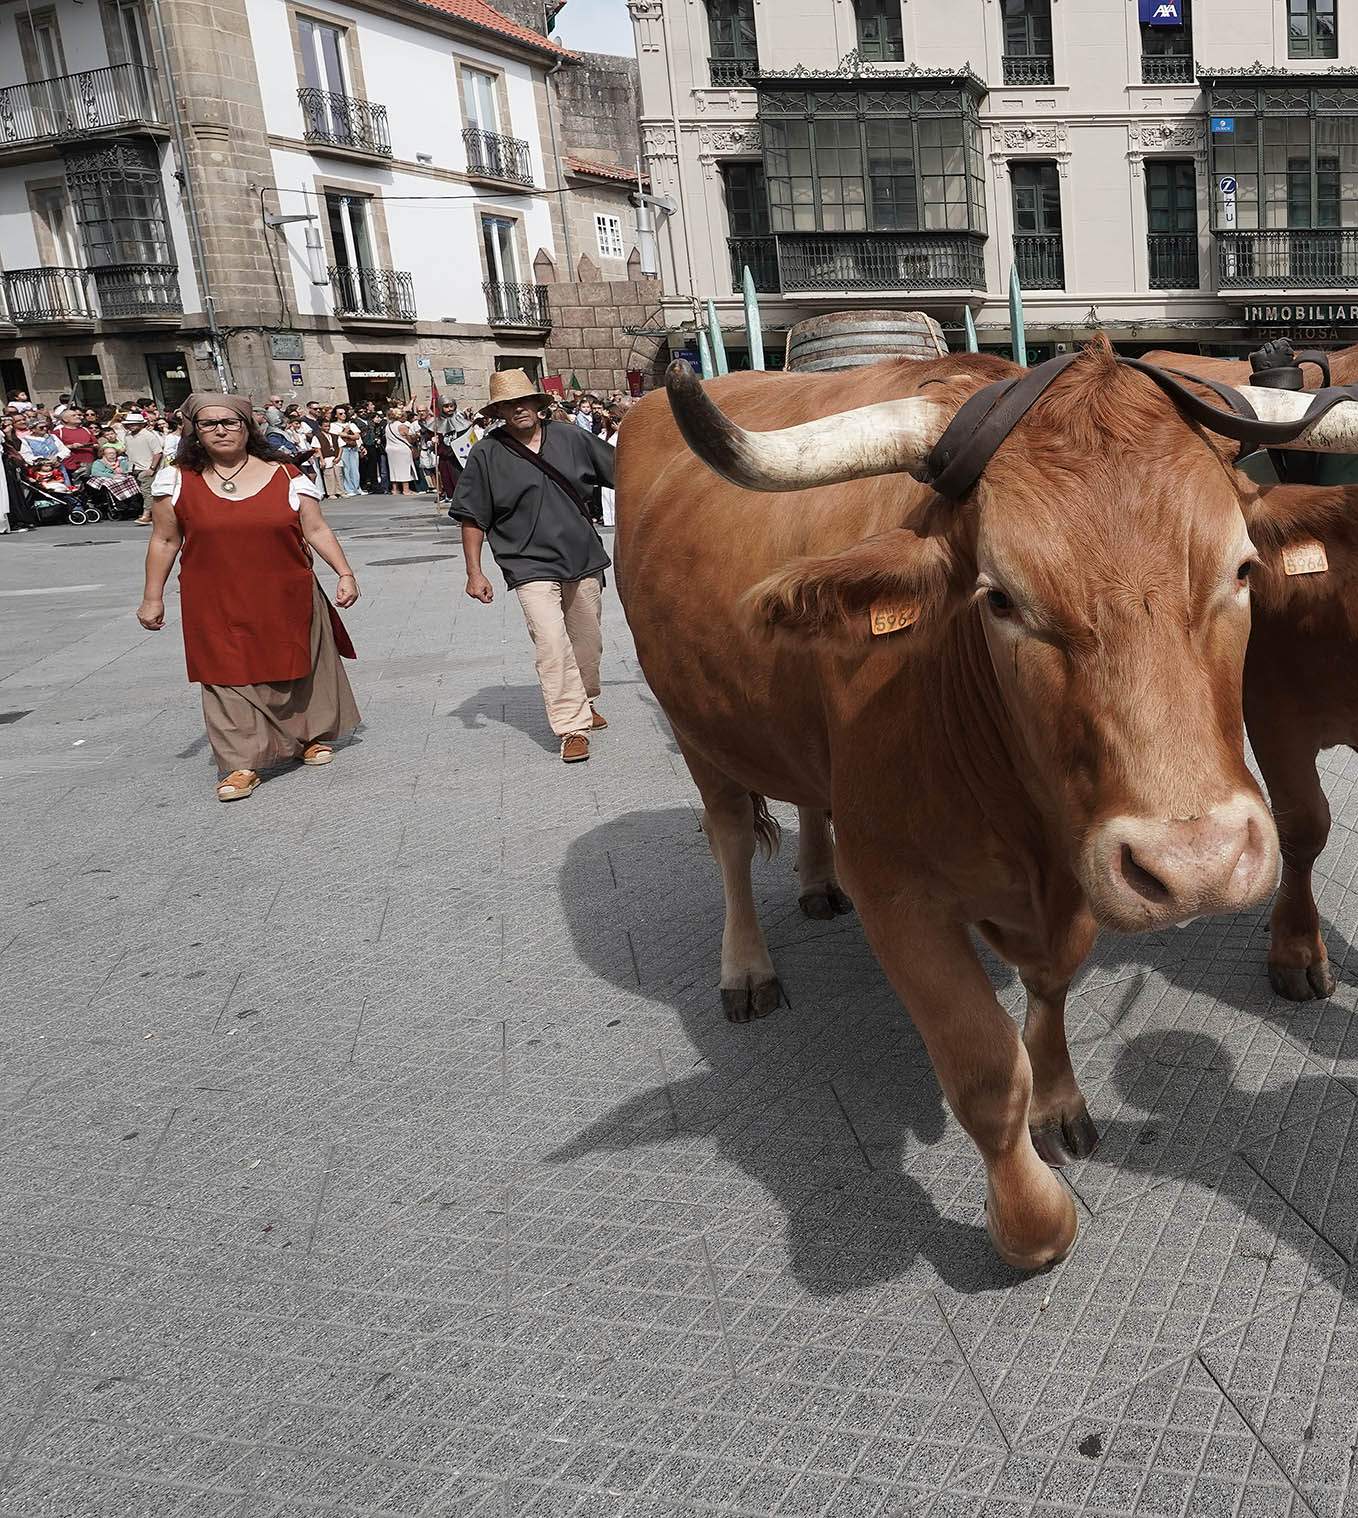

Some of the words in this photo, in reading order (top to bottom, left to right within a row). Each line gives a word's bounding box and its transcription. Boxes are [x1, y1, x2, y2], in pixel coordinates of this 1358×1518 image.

[1152, 4, 1178, 17] AXA
[1258, 328, 1339, 339] PEDROSA
[1287, 556, 1325, 572] 5964
